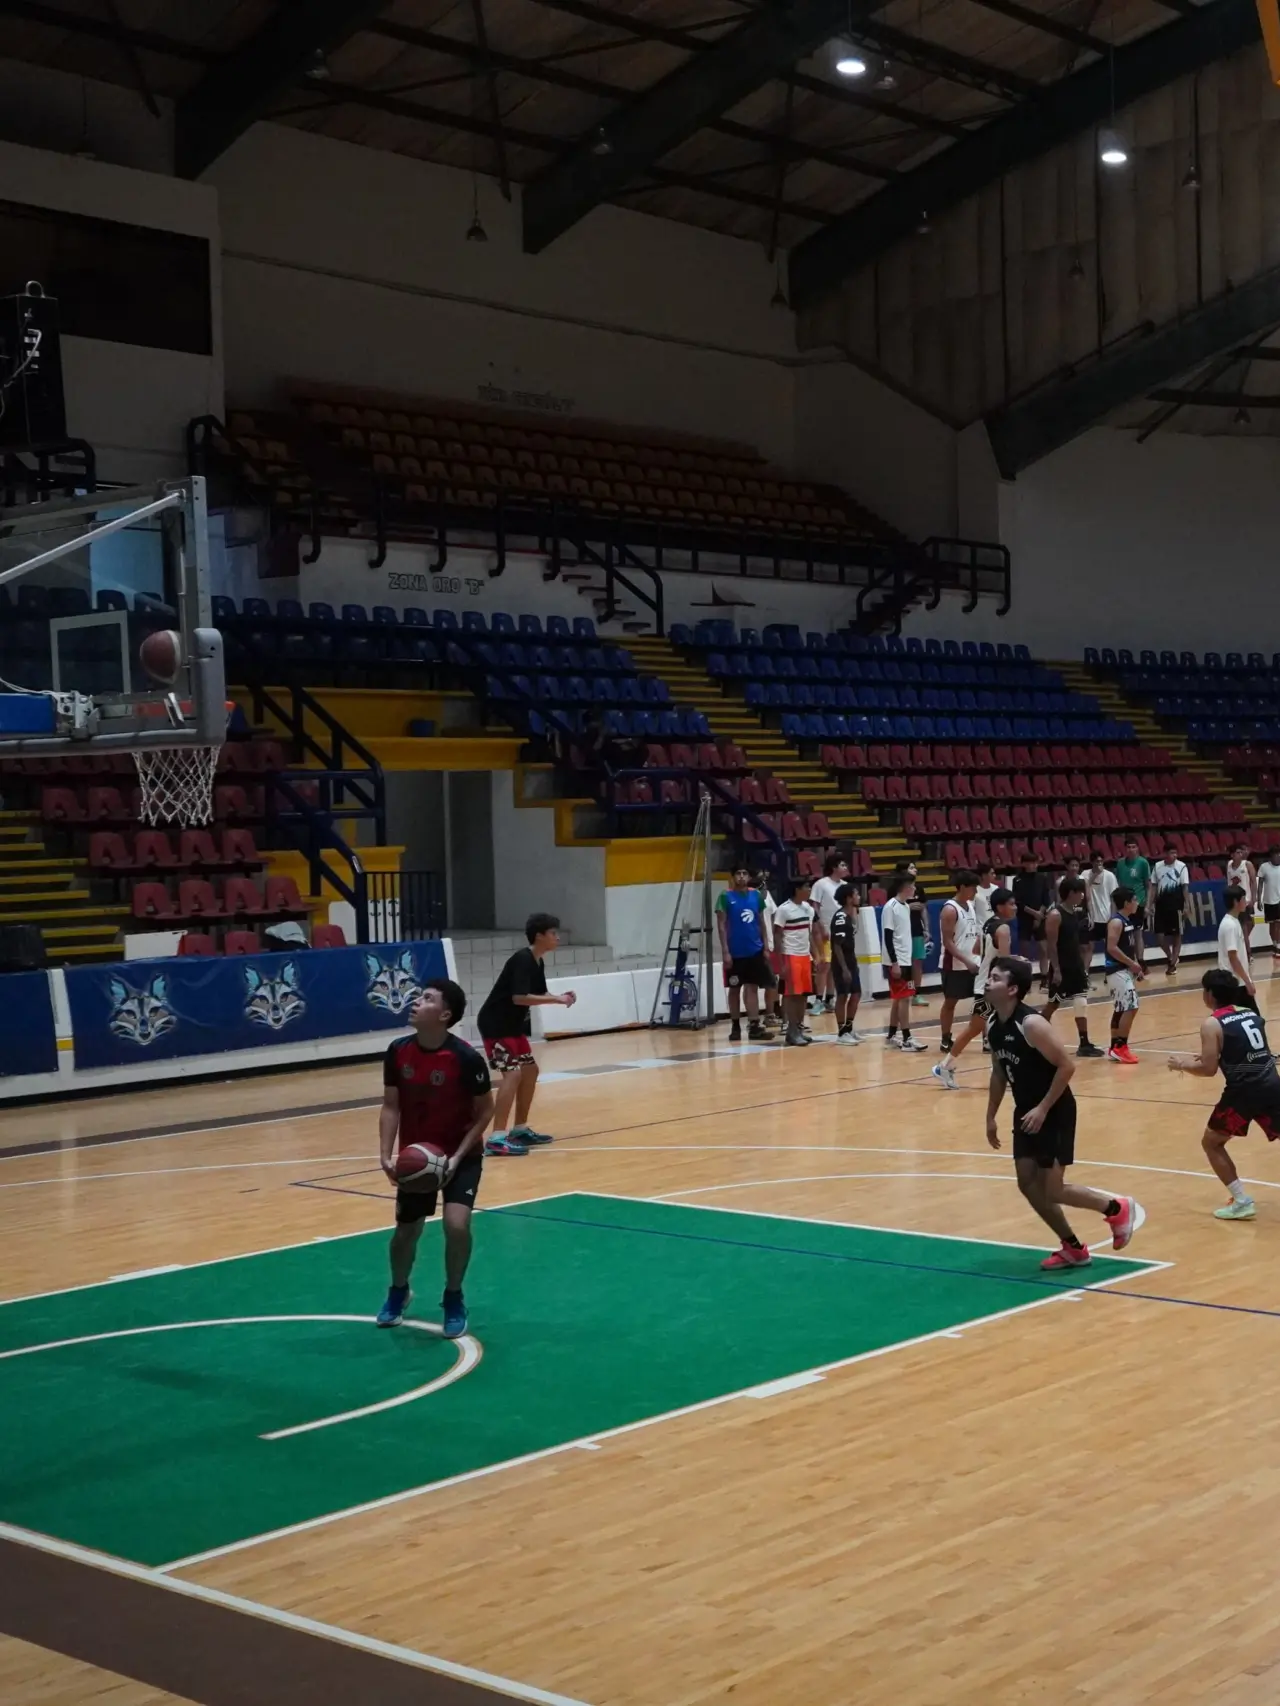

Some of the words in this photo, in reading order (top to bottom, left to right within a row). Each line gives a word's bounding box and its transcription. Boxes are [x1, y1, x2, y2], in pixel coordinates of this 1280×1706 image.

[388, 572, 428, 592] ZONA
[432, 576, 461, 593] ORO
[464, 578, 485, 595] "B"
[1241, 1019, 1265, 1050] 6
